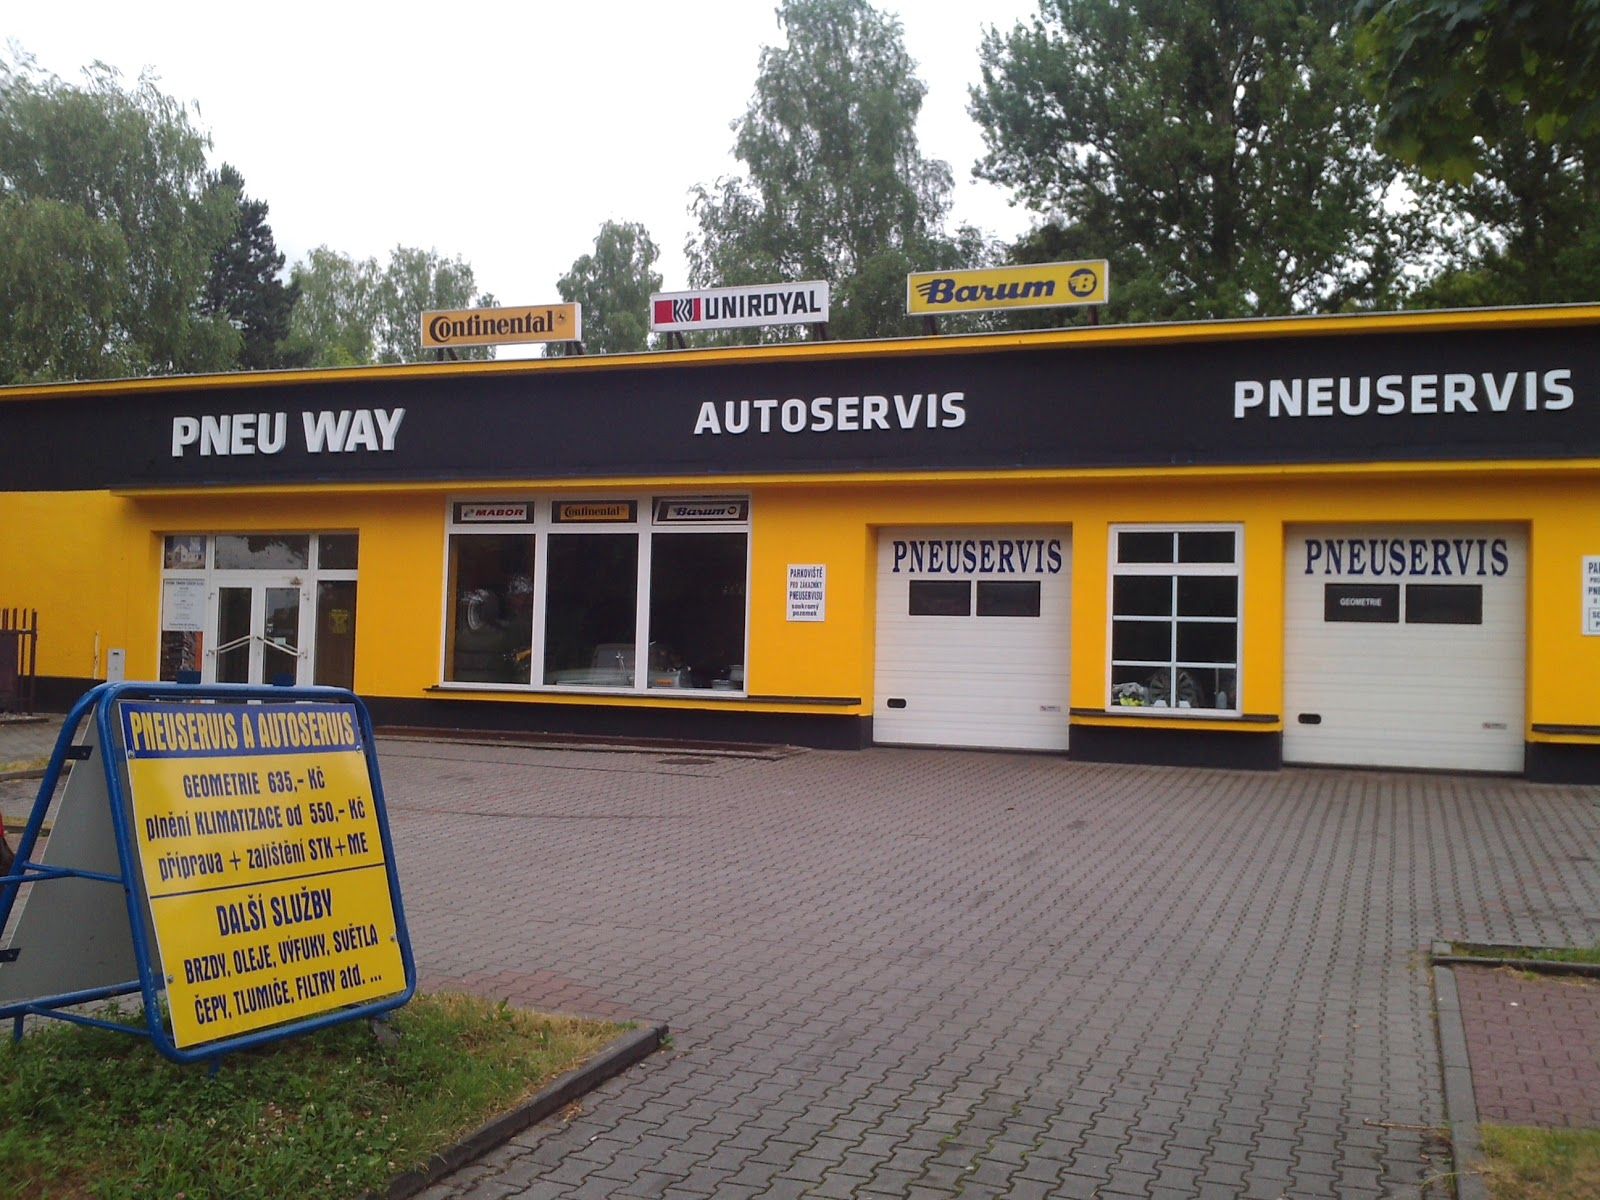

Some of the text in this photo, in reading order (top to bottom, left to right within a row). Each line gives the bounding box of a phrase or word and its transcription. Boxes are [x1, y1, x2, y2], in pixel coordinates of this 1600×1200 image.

[705, 290, 821, 320] UNIROYAL
[919, 279, 1055, 304] Barum
[429, 310, 553, 343] Continental
[1234, 369, 1575, 419] PNEUSERVIS
[172, 407, 406, 457] PNEU WAY
[694, 392, 966, 435] AUTOSERVIS
[475, 509, 524, 517] MABOR
[564, 506, 620, 517] Continental
[675, 507, 726, 516] Barum
[892, 539, 1062, 574] PNEUSERVIS
[1305, 539, 1509, 576] PNEUSERVIS
[1340, 598, 1382, 607] GEOMETRIE
[129, 711, 355, 751] PNEUSERVIS A AUTOSERVIS
[183, 766, 325, 798] GEOMETRIE 635,- Kč
[145, 796, 366, 841] plnění KLIMATIZACE od 550,- Kč
[158, 831, 369, 881] příprava + zajištění STK + ME
[216, 886, 333, 936] DALŠÍ SLUŽBY
[184, 923, 379, 984] BRZDY, OLEJE, VÝFUKY, SVĚTLA
[194, 994, 232, 1025] ČEPY,
[233, 977, 295, 1015] TLUMIČE,
[295, 969, 336, 1001] FILTRY
[339, 963, 366, 990] atd.
